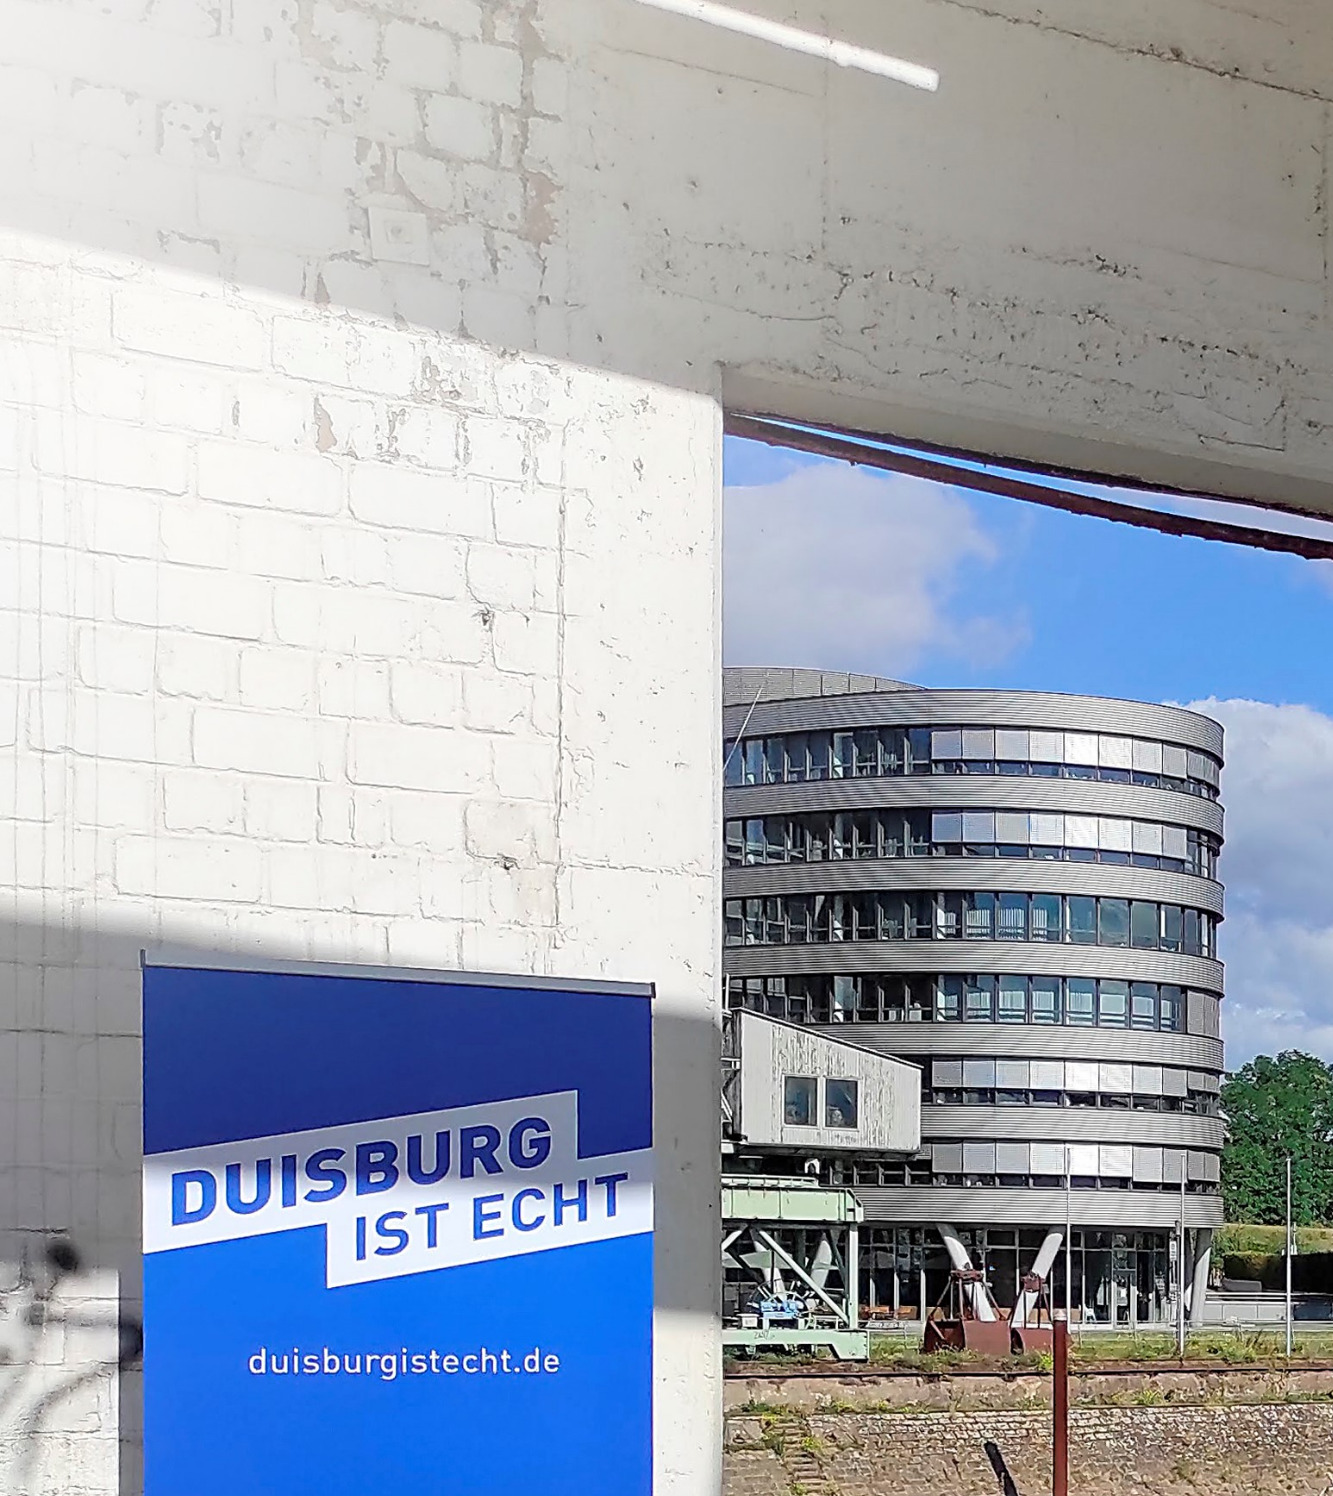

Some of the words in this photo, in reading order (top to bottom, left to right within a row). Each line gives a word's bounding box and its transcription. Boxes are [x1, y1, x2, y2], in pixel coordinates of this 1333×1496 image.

[171, 1117, 552, 1226] DUISBURG
[355, 1202, 450, 1261] IST
[472, 1171, 629, 1241] ECHT
[248, 1346, 560, 1380] duisburgistecht.de
